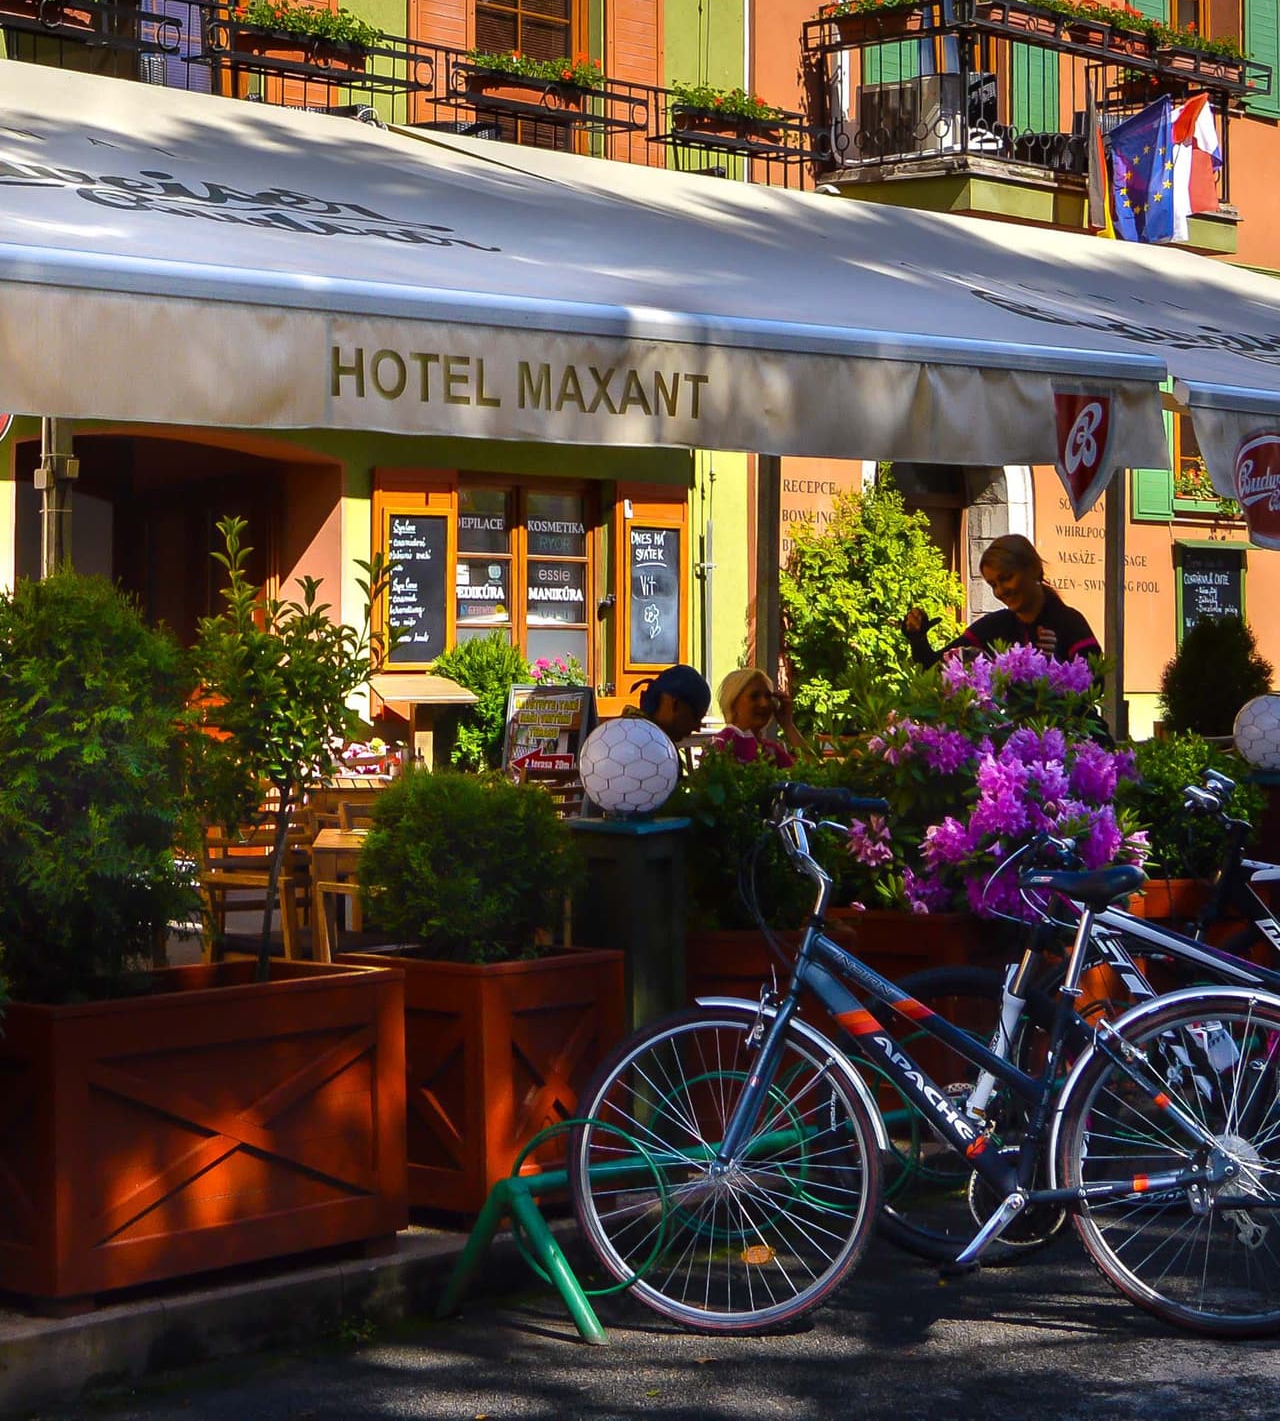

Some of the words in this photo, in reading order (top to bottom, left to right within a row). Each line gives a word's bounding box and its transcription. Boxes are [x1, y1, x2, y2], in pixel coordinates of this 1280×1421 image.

[331, 346, 500, 407] HOTEL
[518, 361, 709, 419] MAXANT
[783, 479, 836, 495] RECEPCE
[527, 520, 585, 534] KOSMETIKA
[1055, 525, 1105, 539] WHIRLPOO
[631, 532, 652, 545] DNES
[538, 568, 570, 581] essie
[528, 585, 584, 601] MANIKÚRA
[1136, 581, 1160, 593] POOL
[873, 1036, 976, 1140] APACHE
